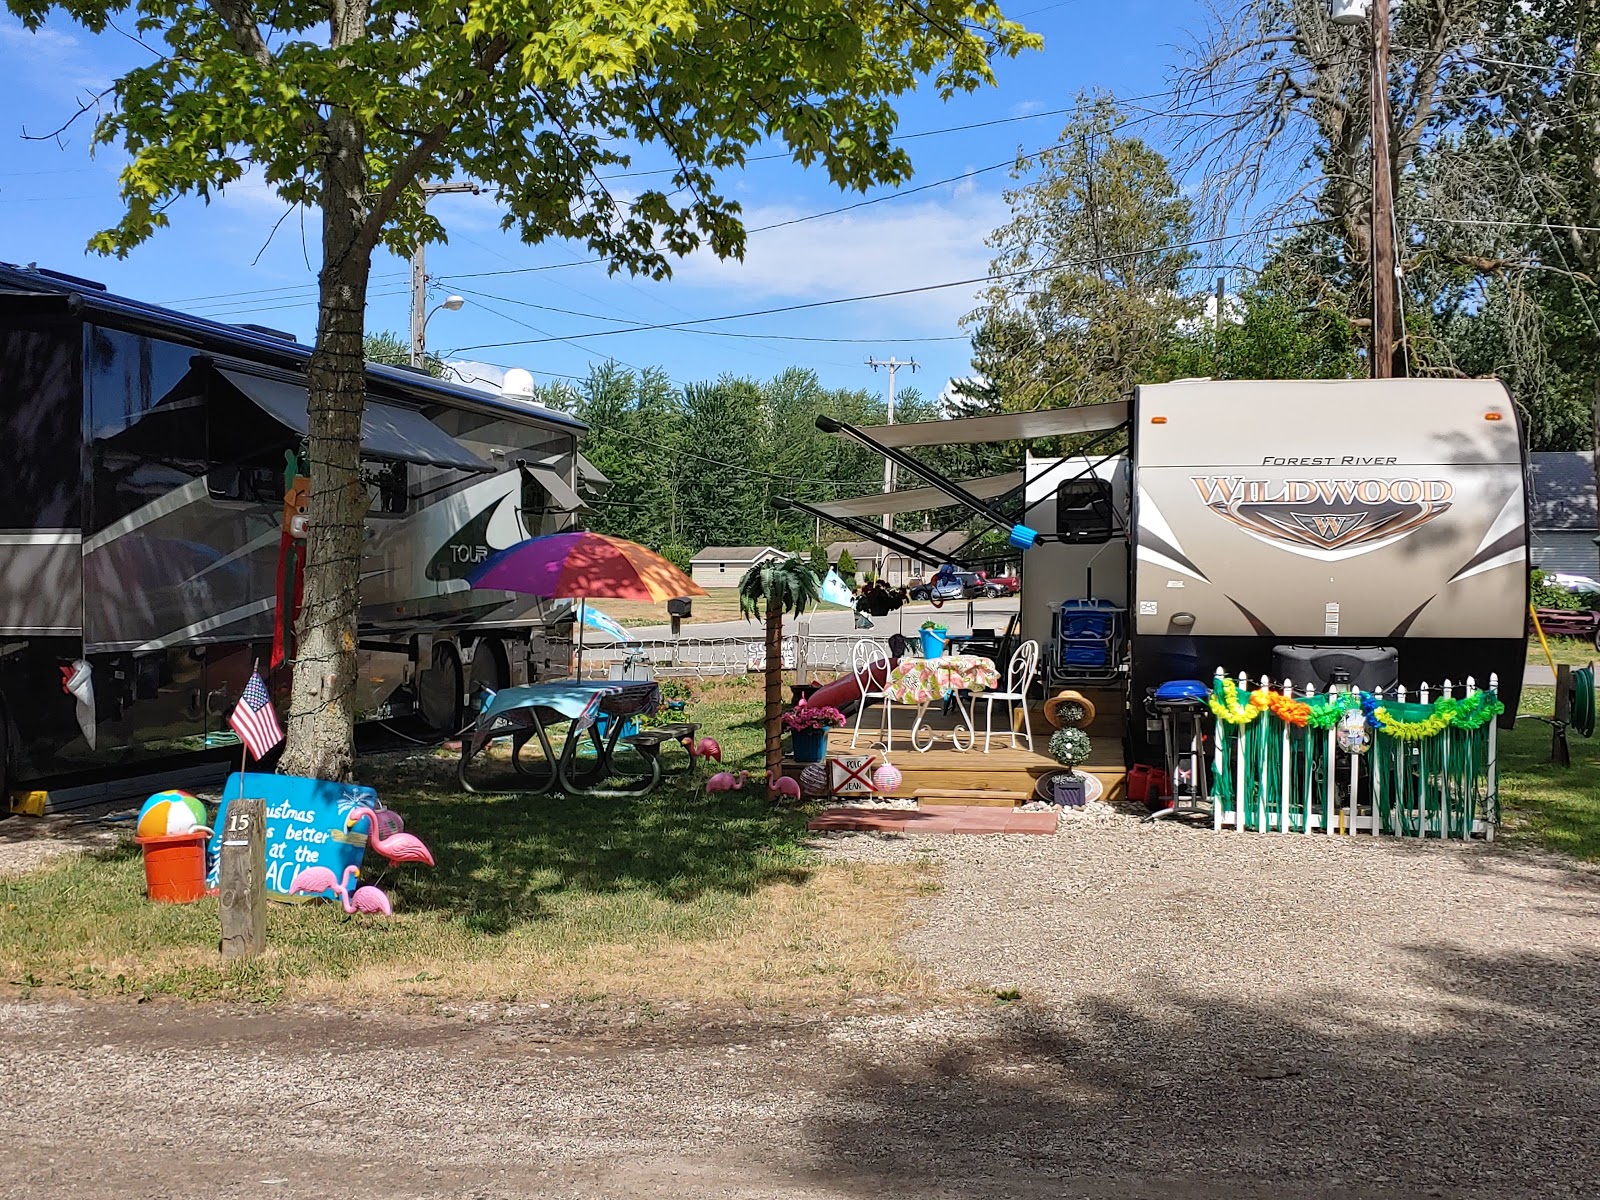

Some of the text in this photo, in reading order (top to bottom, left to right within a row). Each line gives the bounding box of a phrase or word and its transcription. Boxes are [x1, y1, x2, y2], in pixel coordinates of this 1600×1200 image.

[1262, 456, 1398, 466] FOREST RIVER
[1190, 475, 1456, 505] WILDWOOD
[1313, 515, 1346, 538] W
[450, 543, 488, 563] TOUR
[266, 798, 316, 823] istmas
[228, 813, 250, 832] 15
[285, 823, 330, 844] better
[268, 841, 320, 863] at the
